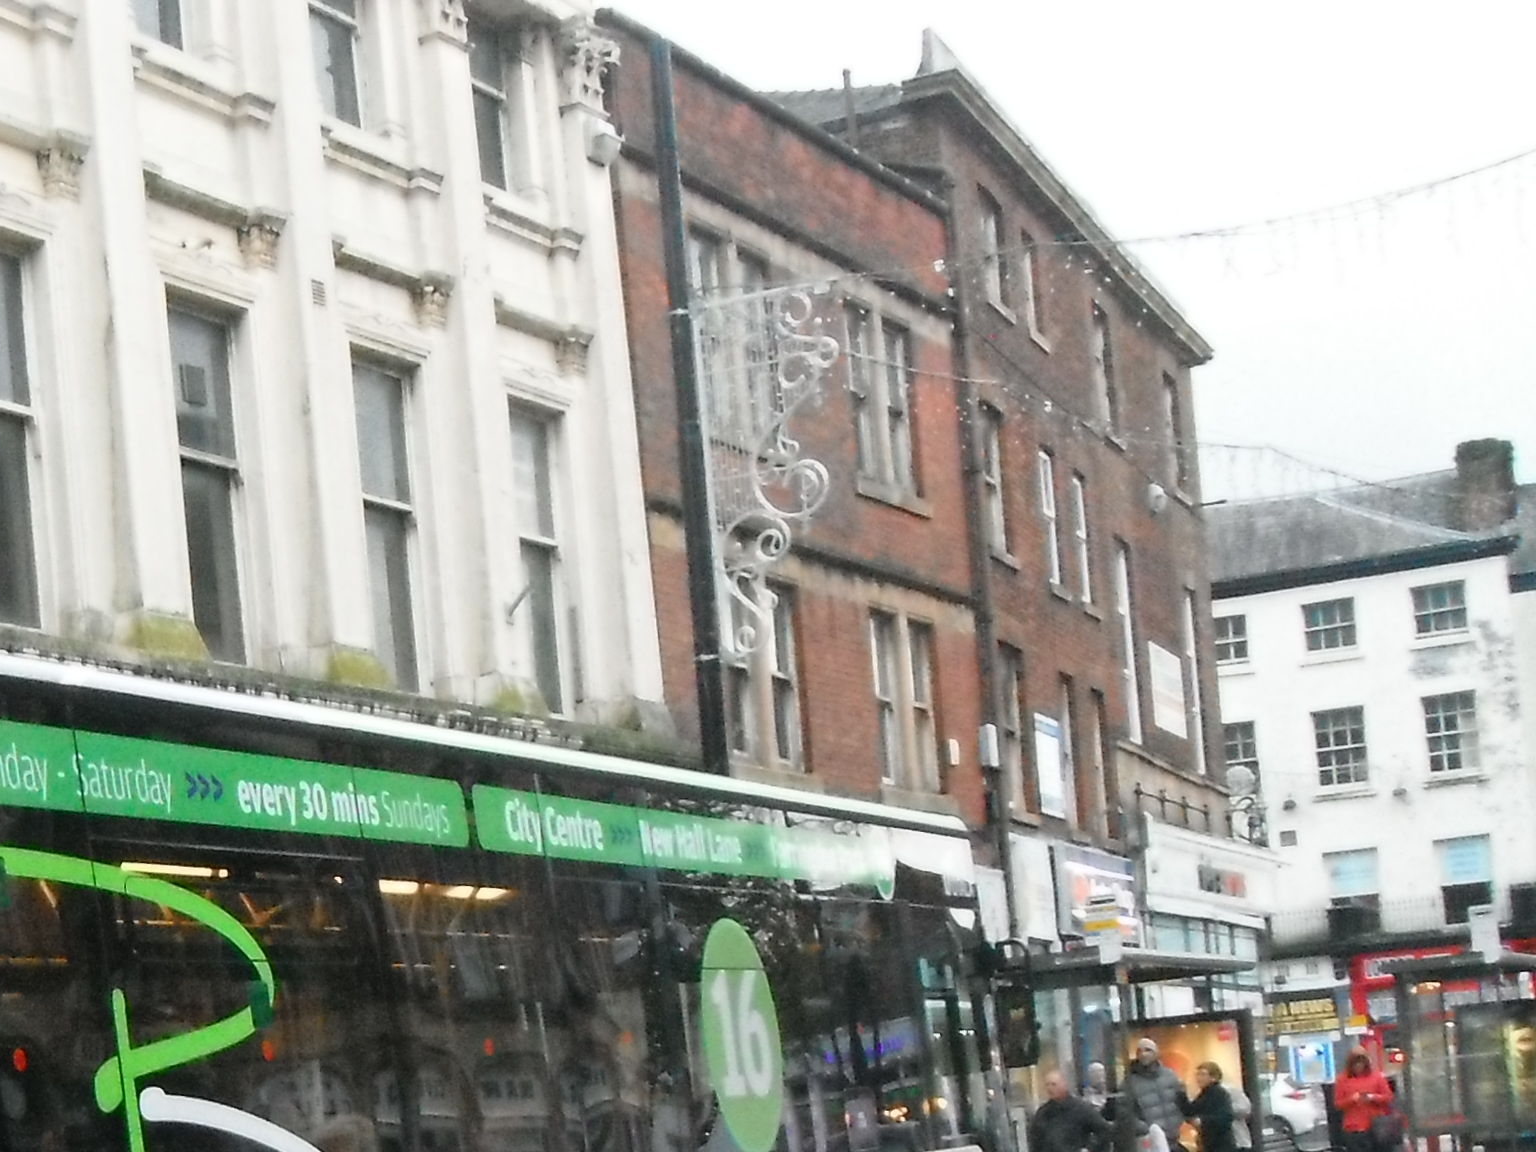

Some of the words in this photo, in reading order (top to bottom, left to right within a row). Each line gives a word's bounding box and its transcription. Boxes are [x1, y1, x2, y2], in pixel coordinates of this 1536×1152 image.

[72, 753, 172, 813] Saturday
[237, 779, 296, 826] every
[299, 780, 328, 821] 30
[331, 783, 380, 826] mins
[381, 791, 451, 838] Sundays
[504, 798, 543, 852] City
[544, 806, 605, 852] Centre
[672, 823, 706, 861] Hall
[707, 827, 743, 864] Lane
[710, 968, 774, 1098] 16
